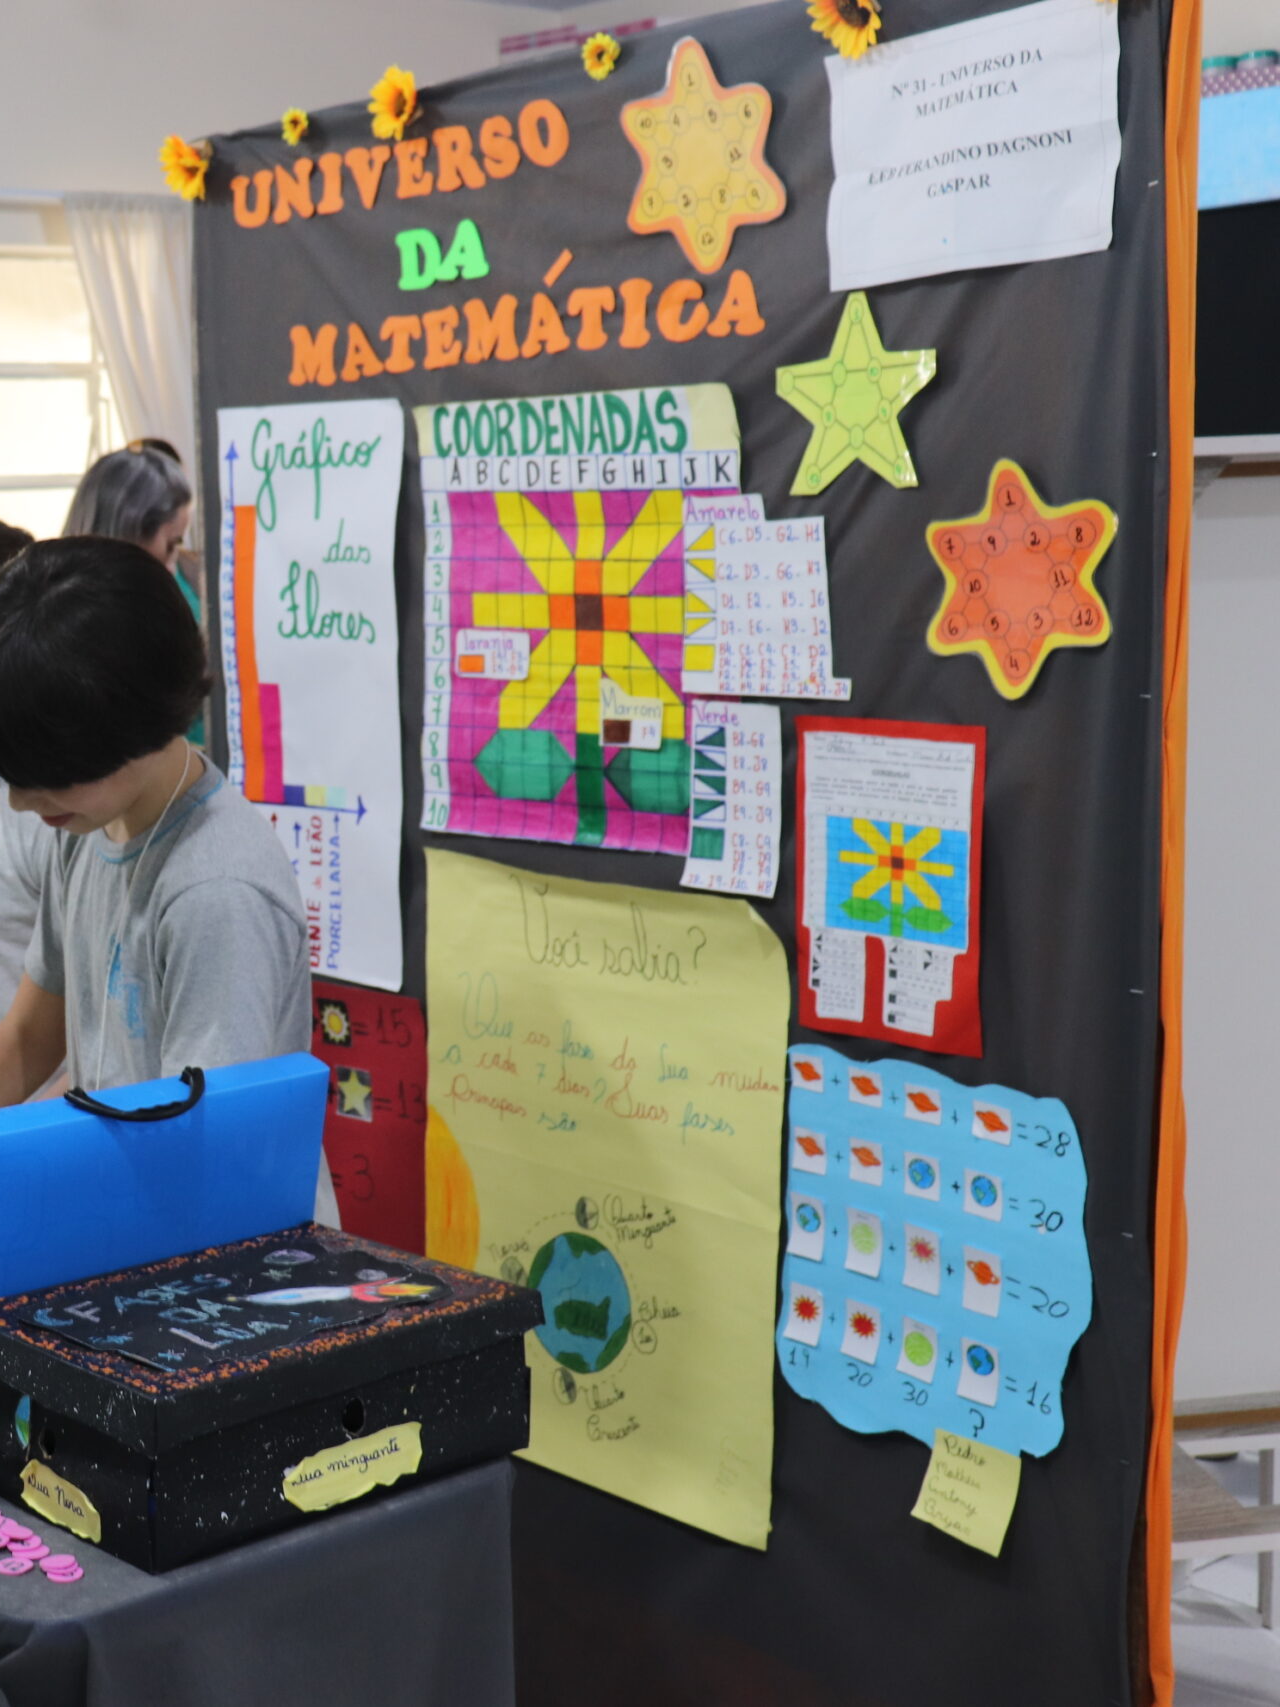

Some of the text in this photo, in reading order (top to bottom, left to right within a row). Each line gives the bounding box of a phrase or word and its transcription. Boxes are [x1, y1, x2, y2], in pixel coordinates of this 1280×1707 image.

[940, 53, 1016, 87] UNIVERSO
[1020, 48, 1044, 64] DA
[916, 79, 1019, 118] MATEMÁTICA
[987, 128, 1073, 157] DAGNONI
[230, 98, 570, 229] UNIVERSO
[926, 172, 991, 199] GASPAR
[394, 218, 490, 291] DA
[287, 248, 766, 387] MATEMÁTICA
[432, 389, 688, 459] COORDENADAS
[250, 417, 382, 532] Gráfico
[450, 453, 731, 487] A B C D E F G H I J K
[431, 500, 440, 524] 1
[685, 495, 760, 522] Amarelo
[1004, 490, 1016, 507] 1
[322, 517, 371, 565] das
[433, 527, 445, 552] 2
[944, 538, 956, 555] 7
[987, 535, 997, 551] 9
[1029, 530, 1042, 548] 2
[1074, 526, 1084, 543] 8
[432, 565, 444, 586] 3
[968, 578, 982, 593] 10
[1052, 570, 1071, 588] 11
[431, 601, 443, 622] 4
[989, 616, 1001, 632] 5
[1033, 612, 1044, 629] 3
[1074, 609, 1094, 628] 12
[947, 618, 960, 637] 6
[431, 633, 446, 655] 5
[432, 662, 446, 690] 6
[1009, 655, 1020, 672] 4
[430, 694, 444, 727] 7
[693, 703, 740, 726] Verde
[428, 730, 440, 758] 8
[430, 763, 444, 789] 9
[424, 797, 448, 828] 10
[325, 835, 342, 970] PORCELANA
[376, 1003, 413, 1049] 15
[1033, 1123, 1072, 1158] 28
[351, 1152, 376, 1201] 3
[1027, 1198, 1064, 1233] 30
[1027, 1284, 1070, 1319] 20
[846, 1361, 874, 1389] 20
[900, 1380, 930, 1408] 30
[968, 1407, 986, 1438] ?
[1025, 1380, 1053, 1416] 16
